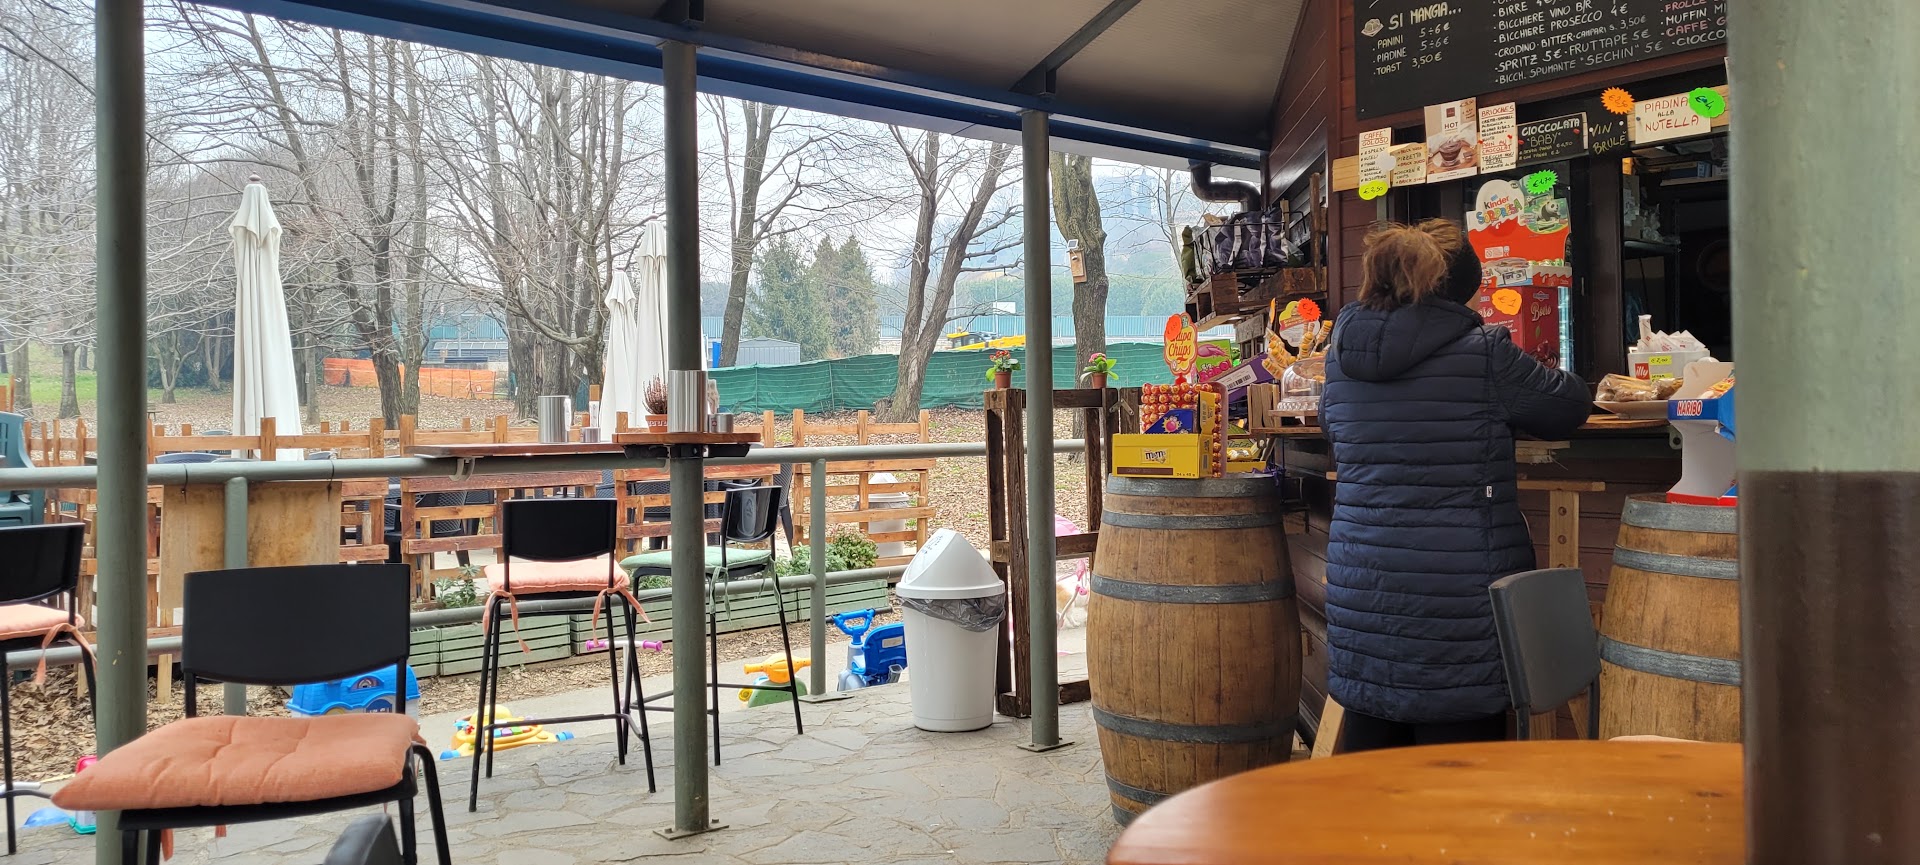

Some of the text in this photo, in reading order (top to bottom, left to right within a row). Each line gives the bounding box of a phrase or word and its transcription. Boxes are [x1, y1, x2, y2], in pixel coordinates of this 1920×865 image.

[1499, 2, 1528, 17] BIRRE
[1666, 7, 1707, 26] MUFFIN
[1389, 13, 1403, 30] SI
[1499, 11, 1545, 30] BICCHIERE
[1550, 5, 1570, 18] VINO
[1499, 24, 1545, 43] BICCHIERE
[1550, 10, 1602, 31] PROSECCO
[1377, 34, 1404, 49] PANINI
[1377, 47, 1407, 62] PIADINE
[1497, 54, 1538, 72] SPRITZ
[1569, 33, 1628, 56] FRUTTAPE
[1376, 61, 1402, 75] TOAST
[1529, 60, 1576, 78] SPUMANTE
[1482, 105, 1515, 117] BRIOCHES
[1644, 96, 1688, 113] PIADINA
[1657, 109, 1675, 117] ALLA
[1521, 118, 1580, 136] CIOCCOLATA
[1592, 122, 1612, 137] VIN
[1645, 114, 1699, 132] NUTELLA
[1362, 137, 1389, 146] GOLOSO
[1169, 343, 1191, 358] Chups
[1636, 366, 1648, 379] illy
[1677, 400, 1703, 416] HARIBO
